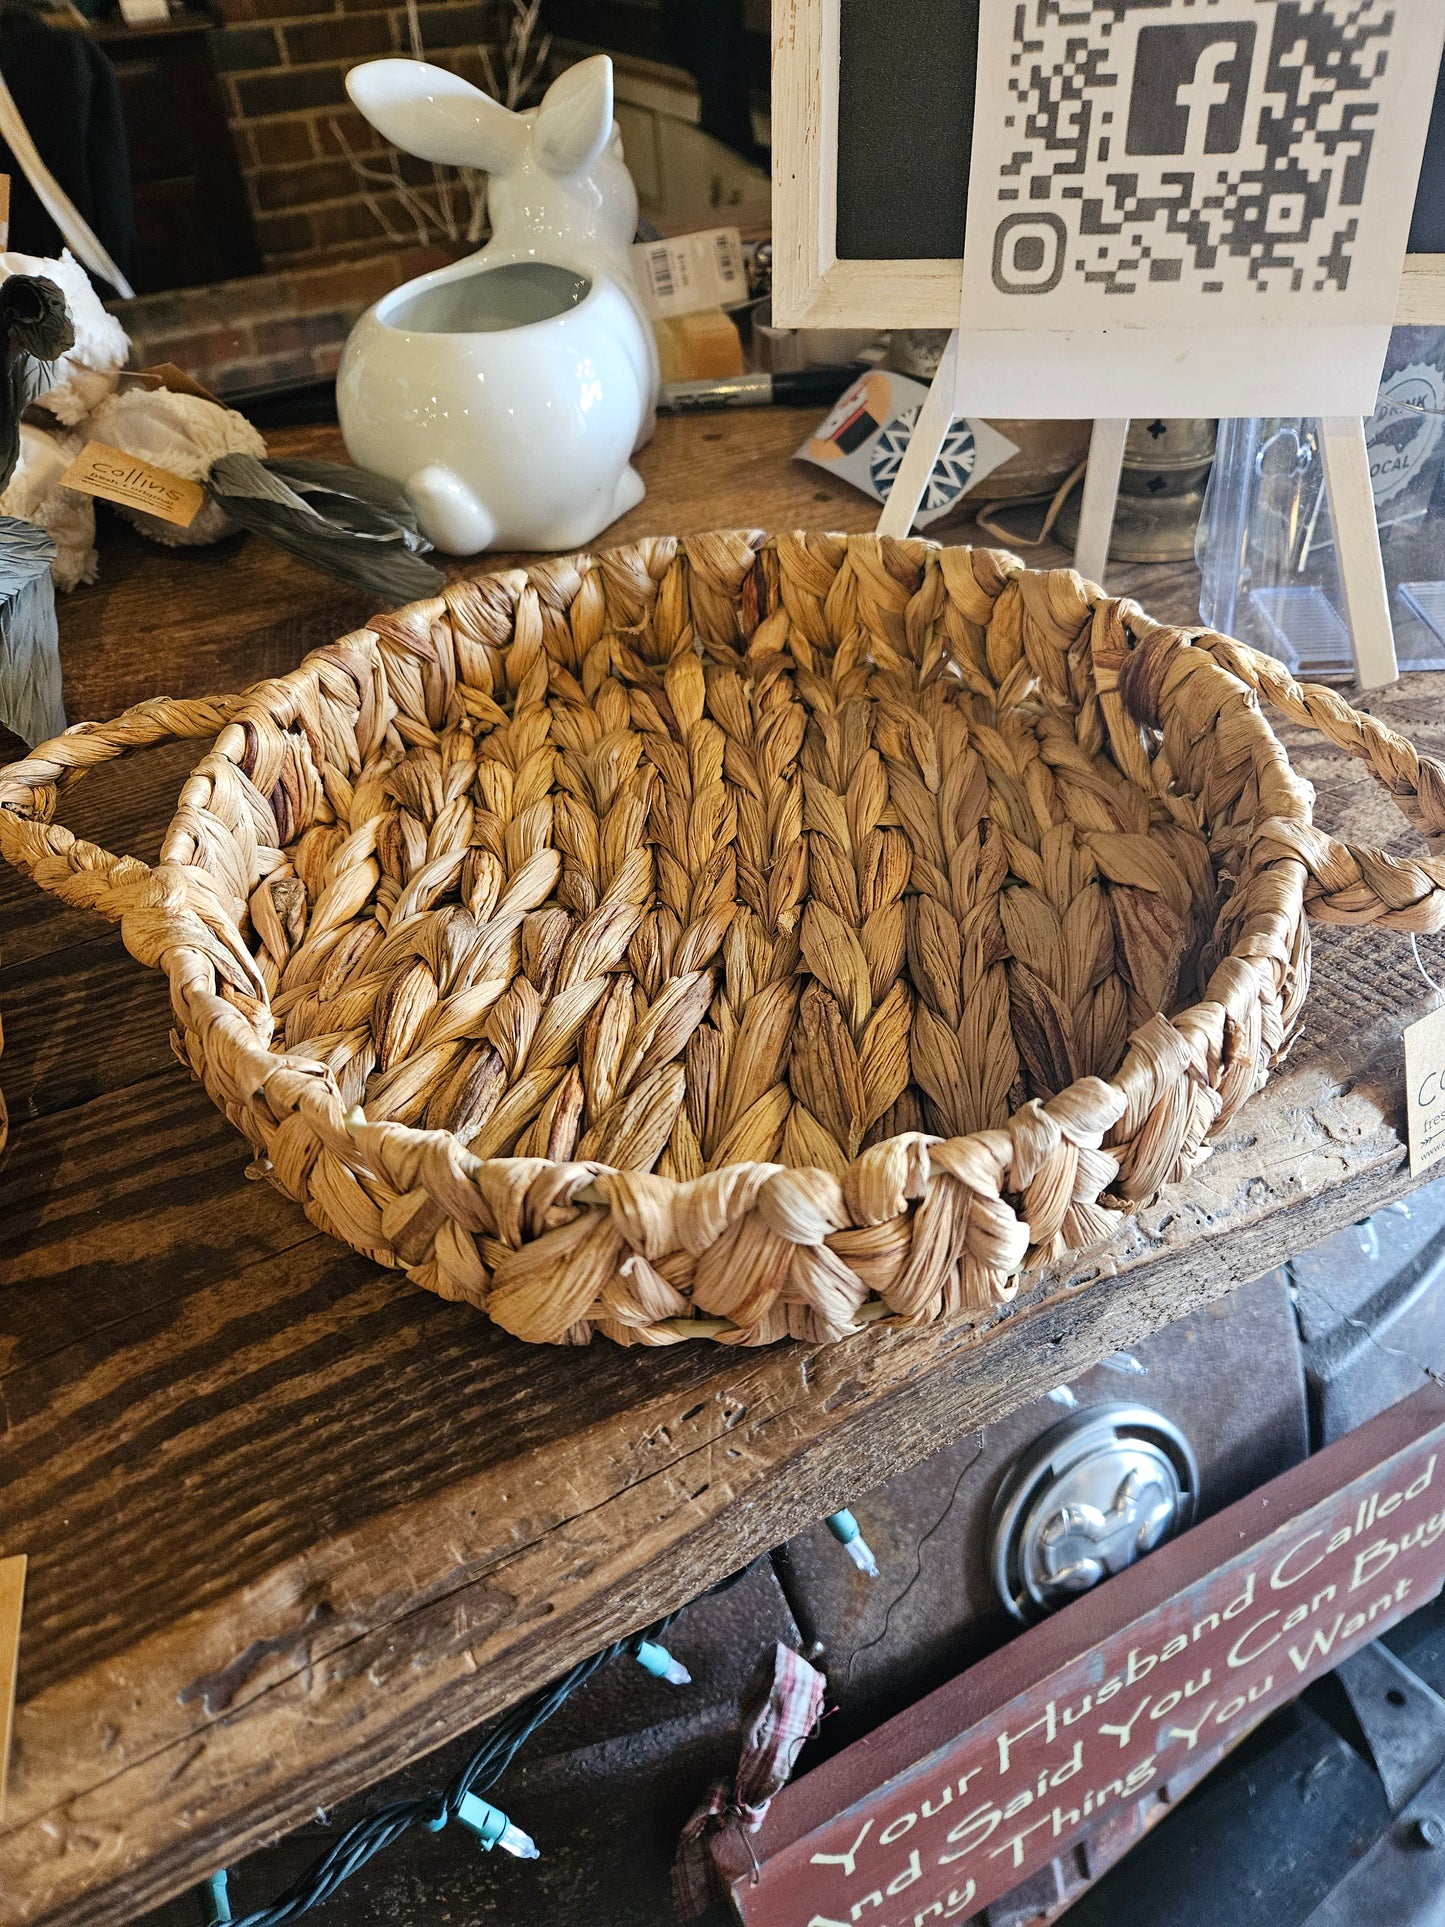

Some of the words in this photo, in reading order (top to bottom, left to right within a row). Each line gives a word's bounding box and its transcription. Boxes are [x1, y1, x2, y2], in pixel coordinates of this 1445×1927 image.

[1370, 454, 1410, 478] OCAL
[809, 1766, 983, 1876] Your
[997, 1572, 1256, 1775] Husband
[1269, 1454, 1438, 1590] Called
[937, 1740, 1084, 1865] Said
[1098, 1668, 1212, 1749] You
[1227, 1585, 1337, 1669] Can
[1348, 1508, 1445, 1592] Buy
[988, 1753, 1158, 1868] Thing
[1169, 1675, 1274, 1750] You
[1288, 1578, 1412, 1674] Want
